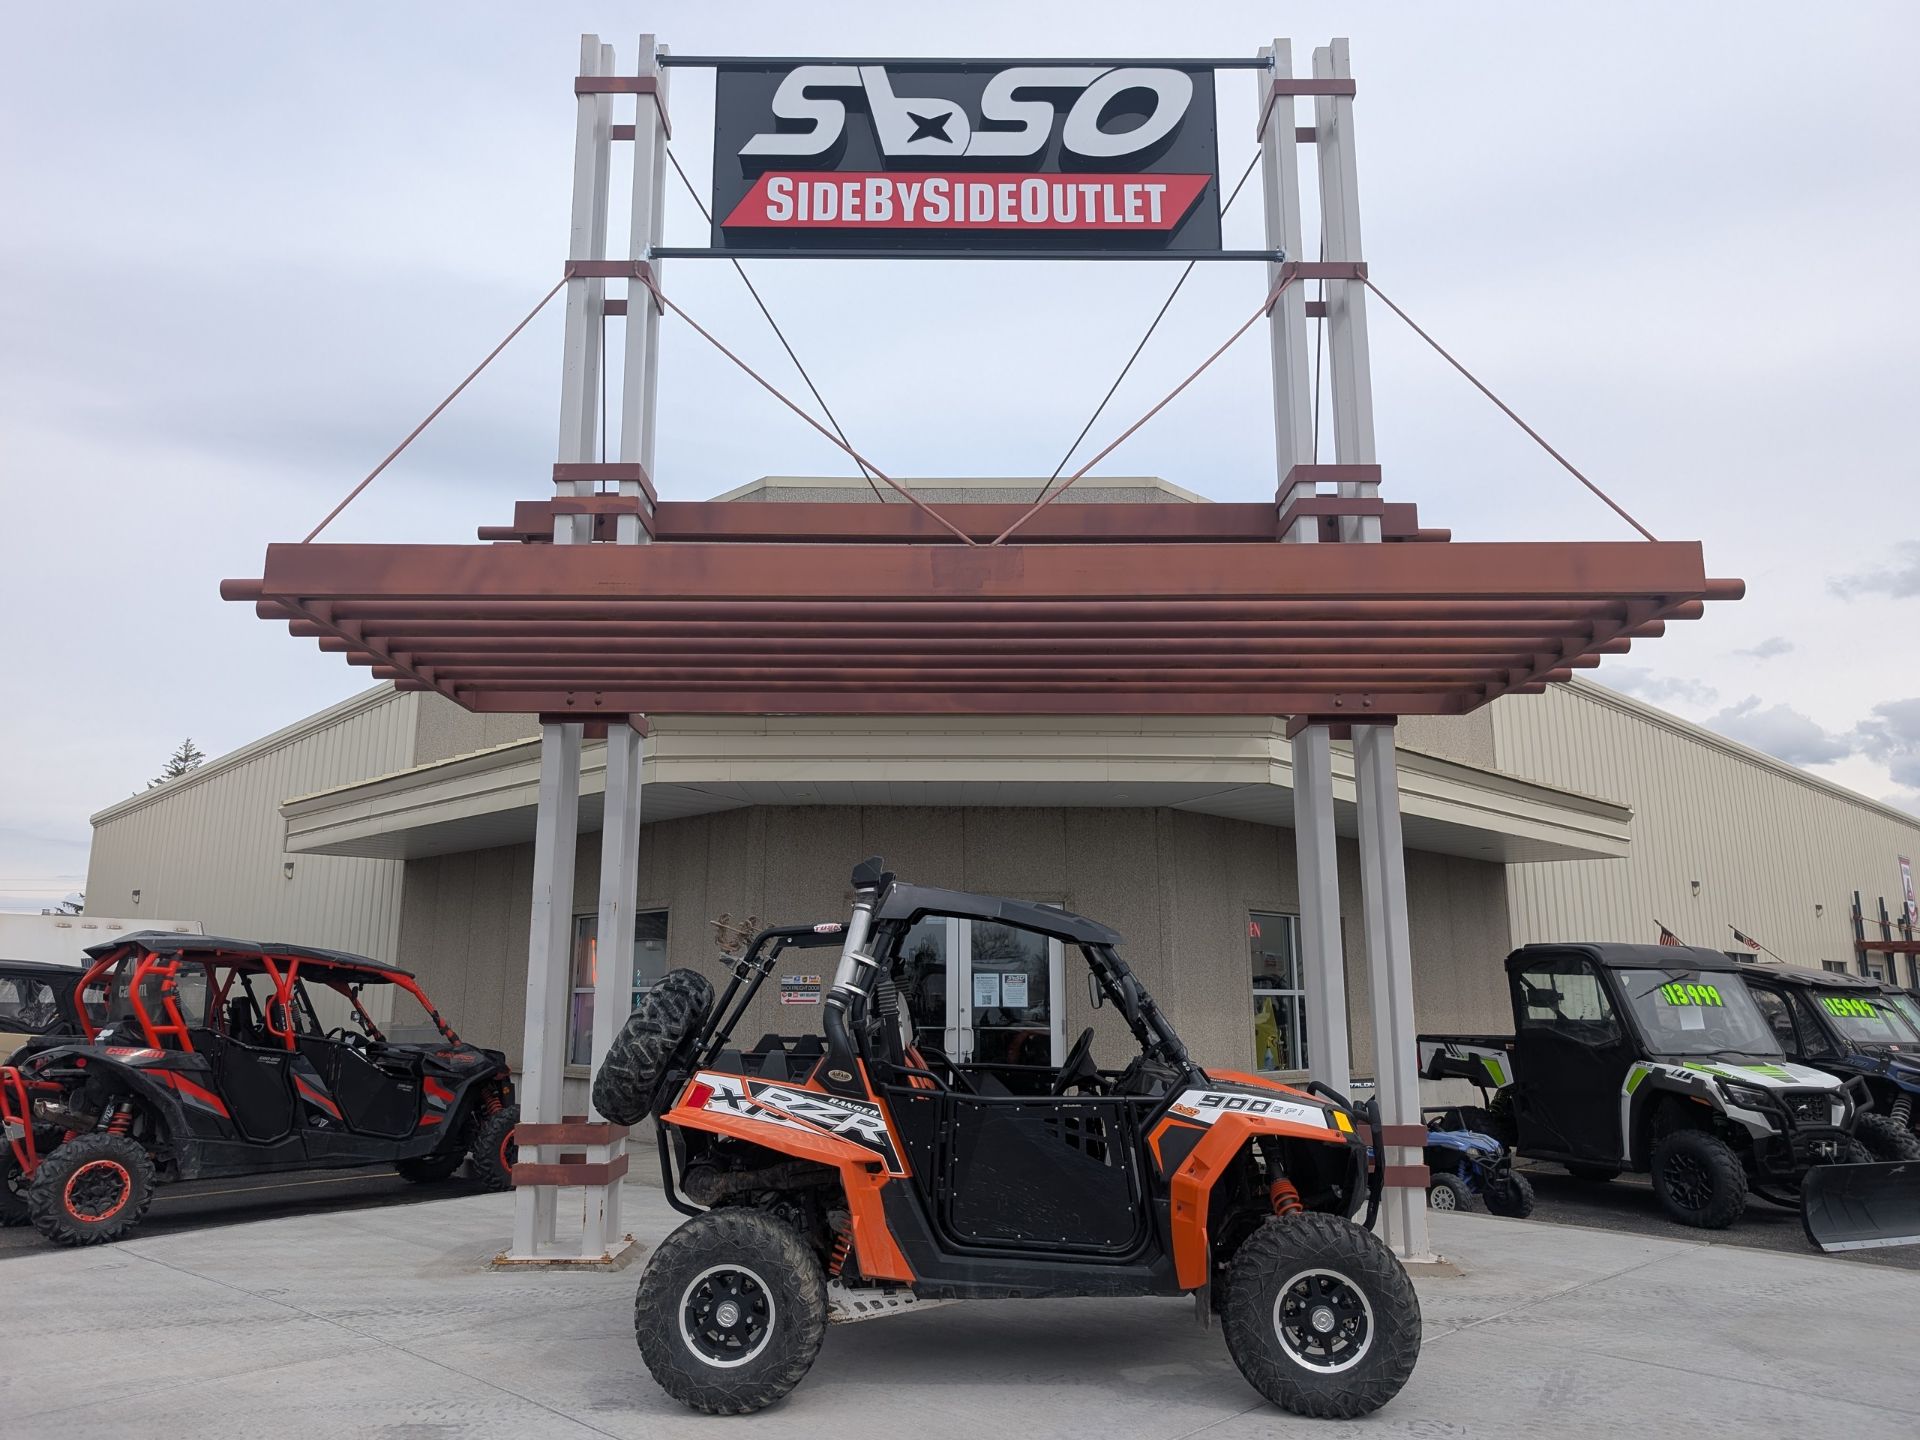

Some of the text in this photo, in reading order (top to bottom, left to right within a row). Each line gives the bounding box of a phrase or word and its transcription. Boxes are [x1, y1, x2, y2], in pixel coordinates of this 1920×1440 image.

[828, 1097, 879, 1116] RANGER
[1197, 1094, 1274, 1114] 900
[751, 1087, 887, 1147] RZR
